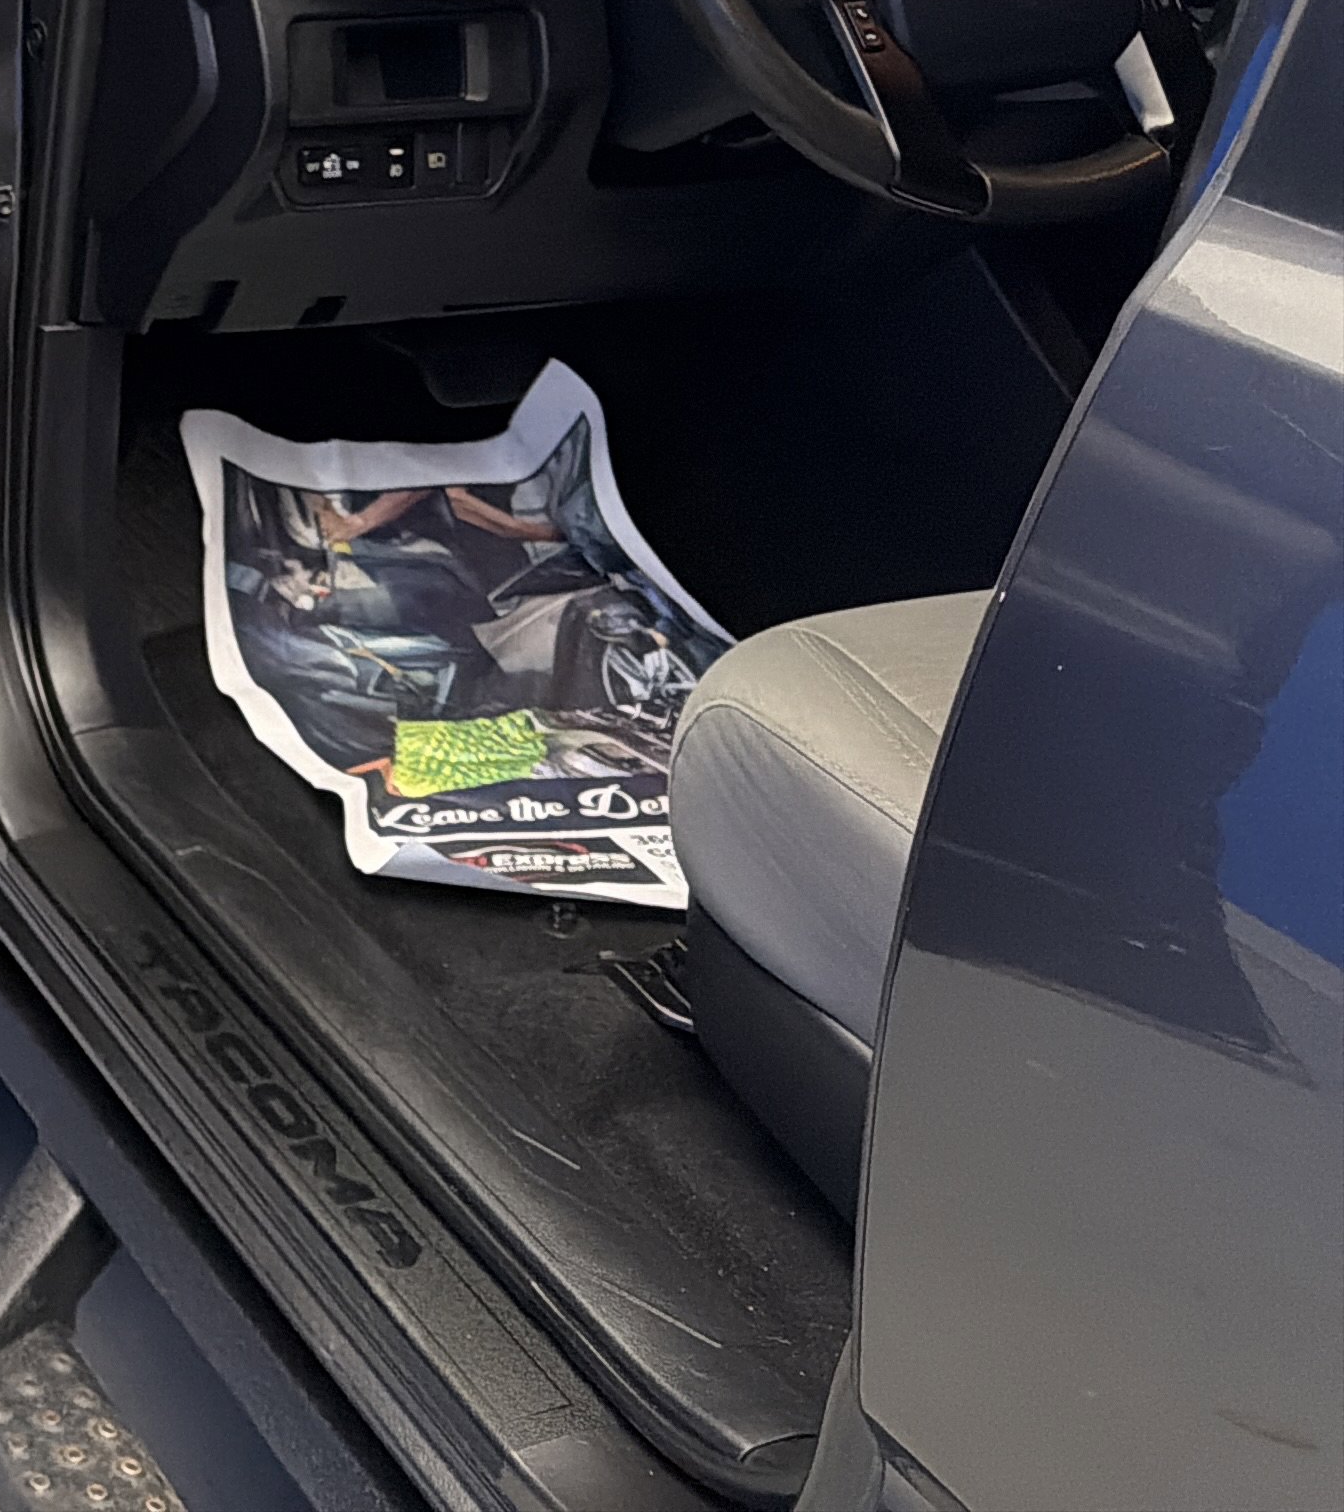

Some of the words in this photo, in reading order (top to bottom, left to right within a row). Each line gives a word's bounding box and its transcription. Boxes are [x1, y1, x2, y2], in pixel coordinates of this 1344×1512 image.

[372, 803, 504, 833] Leave
[506, 795, 571, 822] the
[134, 928, 423, 1270] TACOMA
